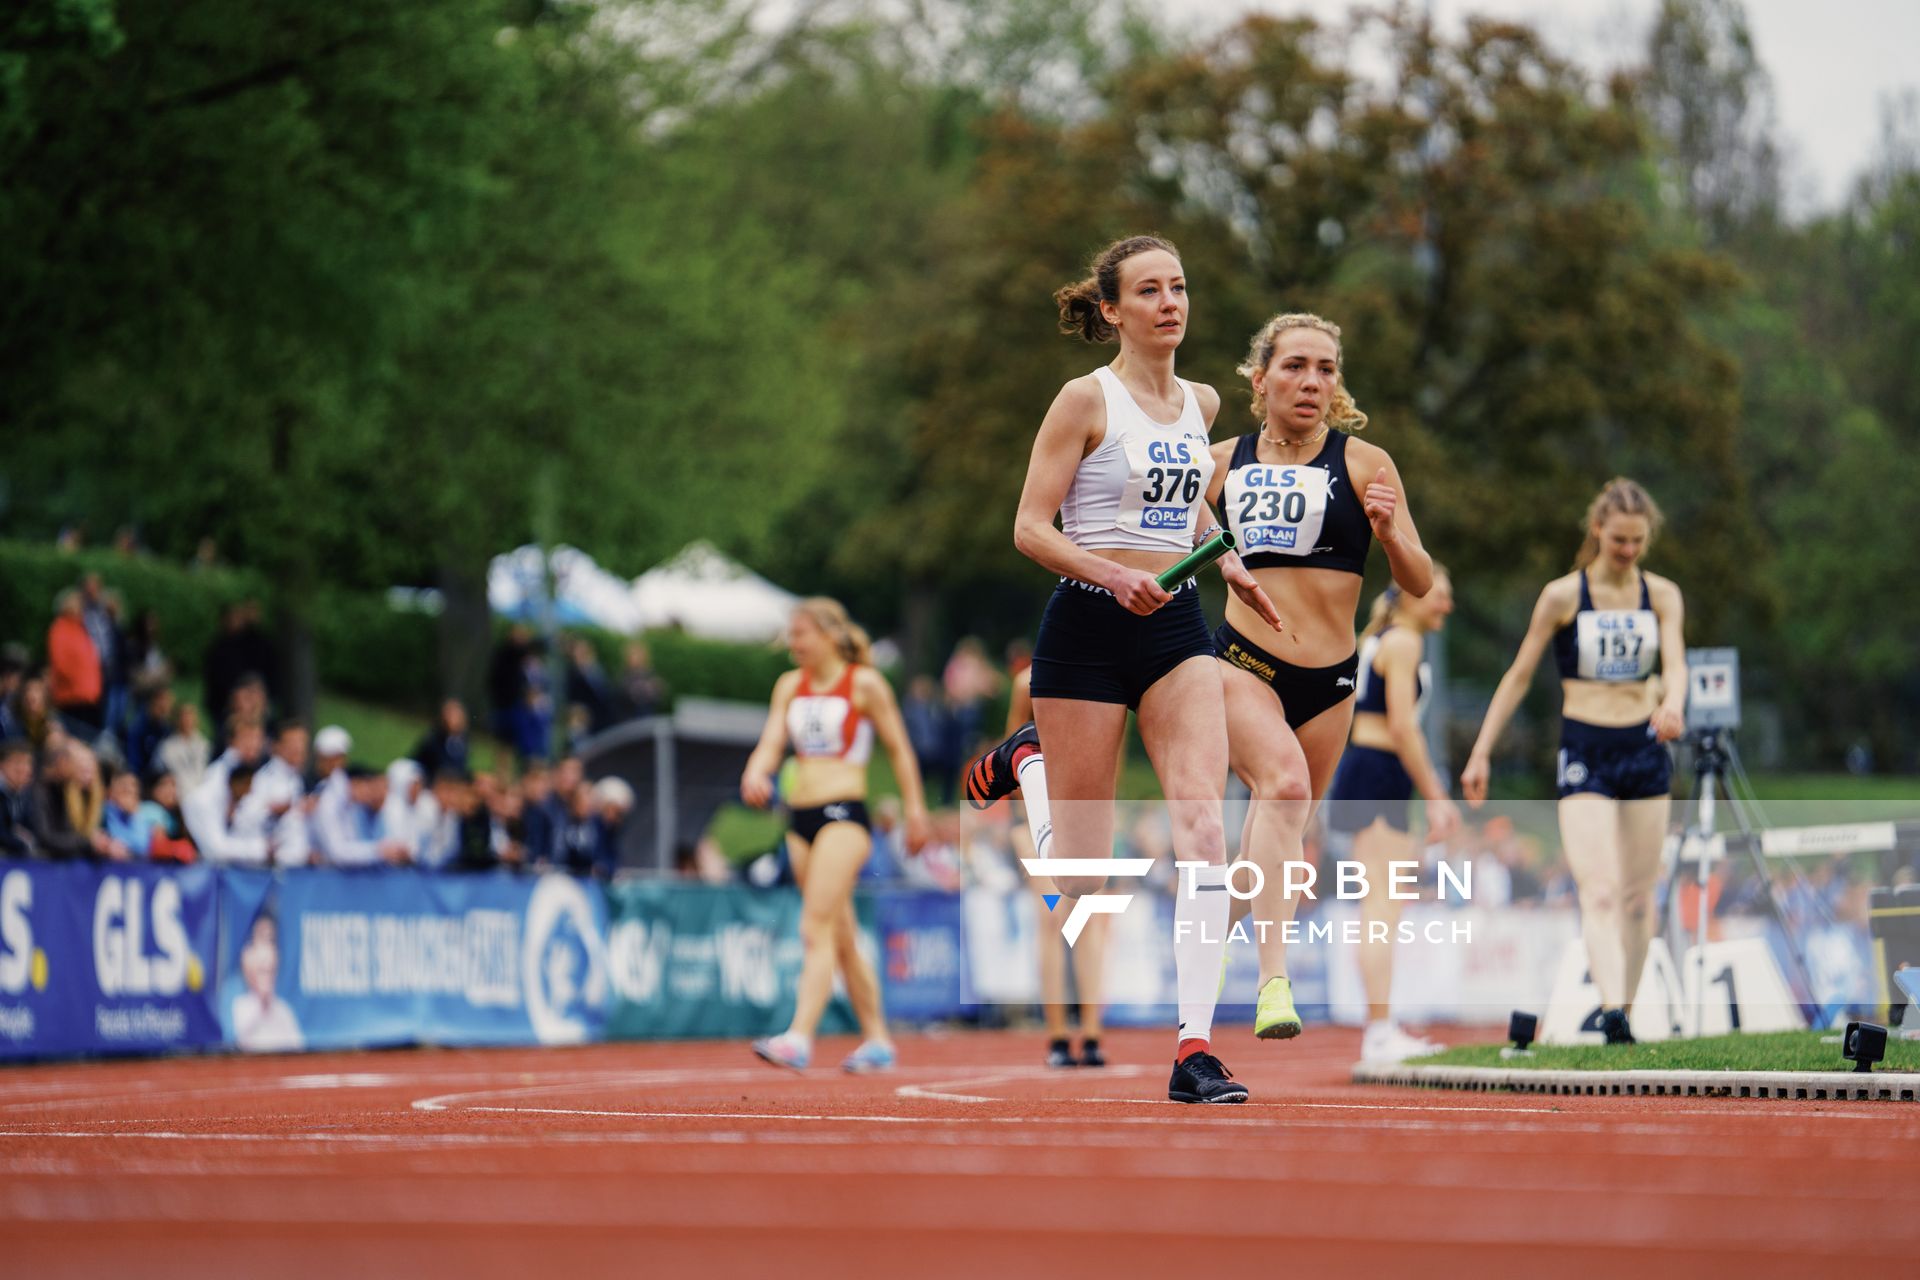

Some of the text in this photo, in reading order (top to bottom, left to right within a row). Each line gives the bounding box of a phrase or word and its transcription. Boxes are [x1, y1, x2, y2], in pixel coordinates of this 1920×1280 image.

[1143, 467, 1201, 504] 376
[1238, 490, 1306, 524] 230
[1262, 528, 1294, 541] PLAN
[1597, 633, 1643, 657] 157
